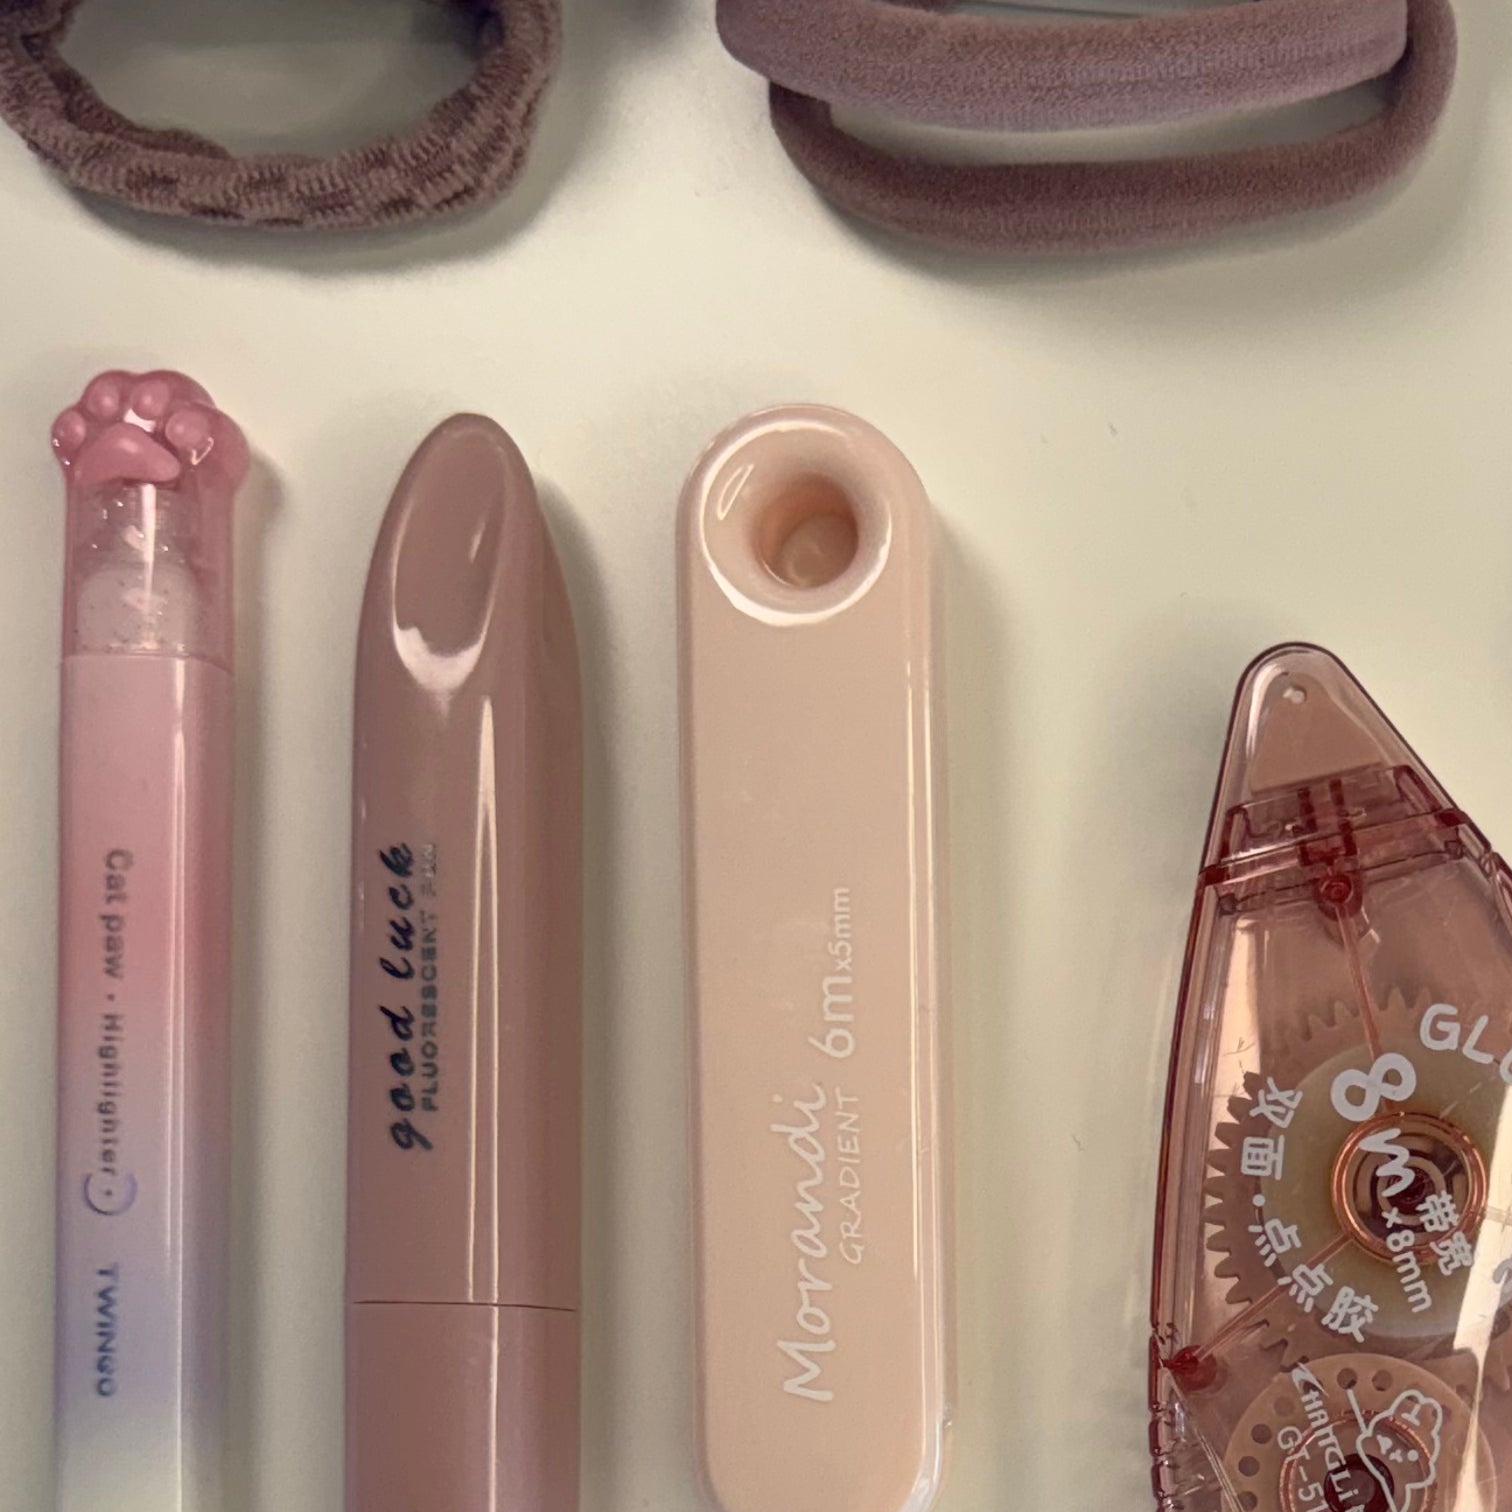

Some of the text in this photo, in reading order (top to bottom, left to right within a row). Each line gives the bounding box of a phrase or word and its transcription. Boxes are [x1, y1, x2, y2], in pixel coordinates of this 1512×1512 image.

[97, 849, 134, 1177] Cat paw Highlighter
[380, 843, 433, 1150] good luck
[420, 910, 438, 1112] FLUORESCENT
[770, 1084, 837, 1402] Morandi
[833, 1086, 864, 1265] GRADIENT
[1417, 1189, 1474, 1277] 带宽
